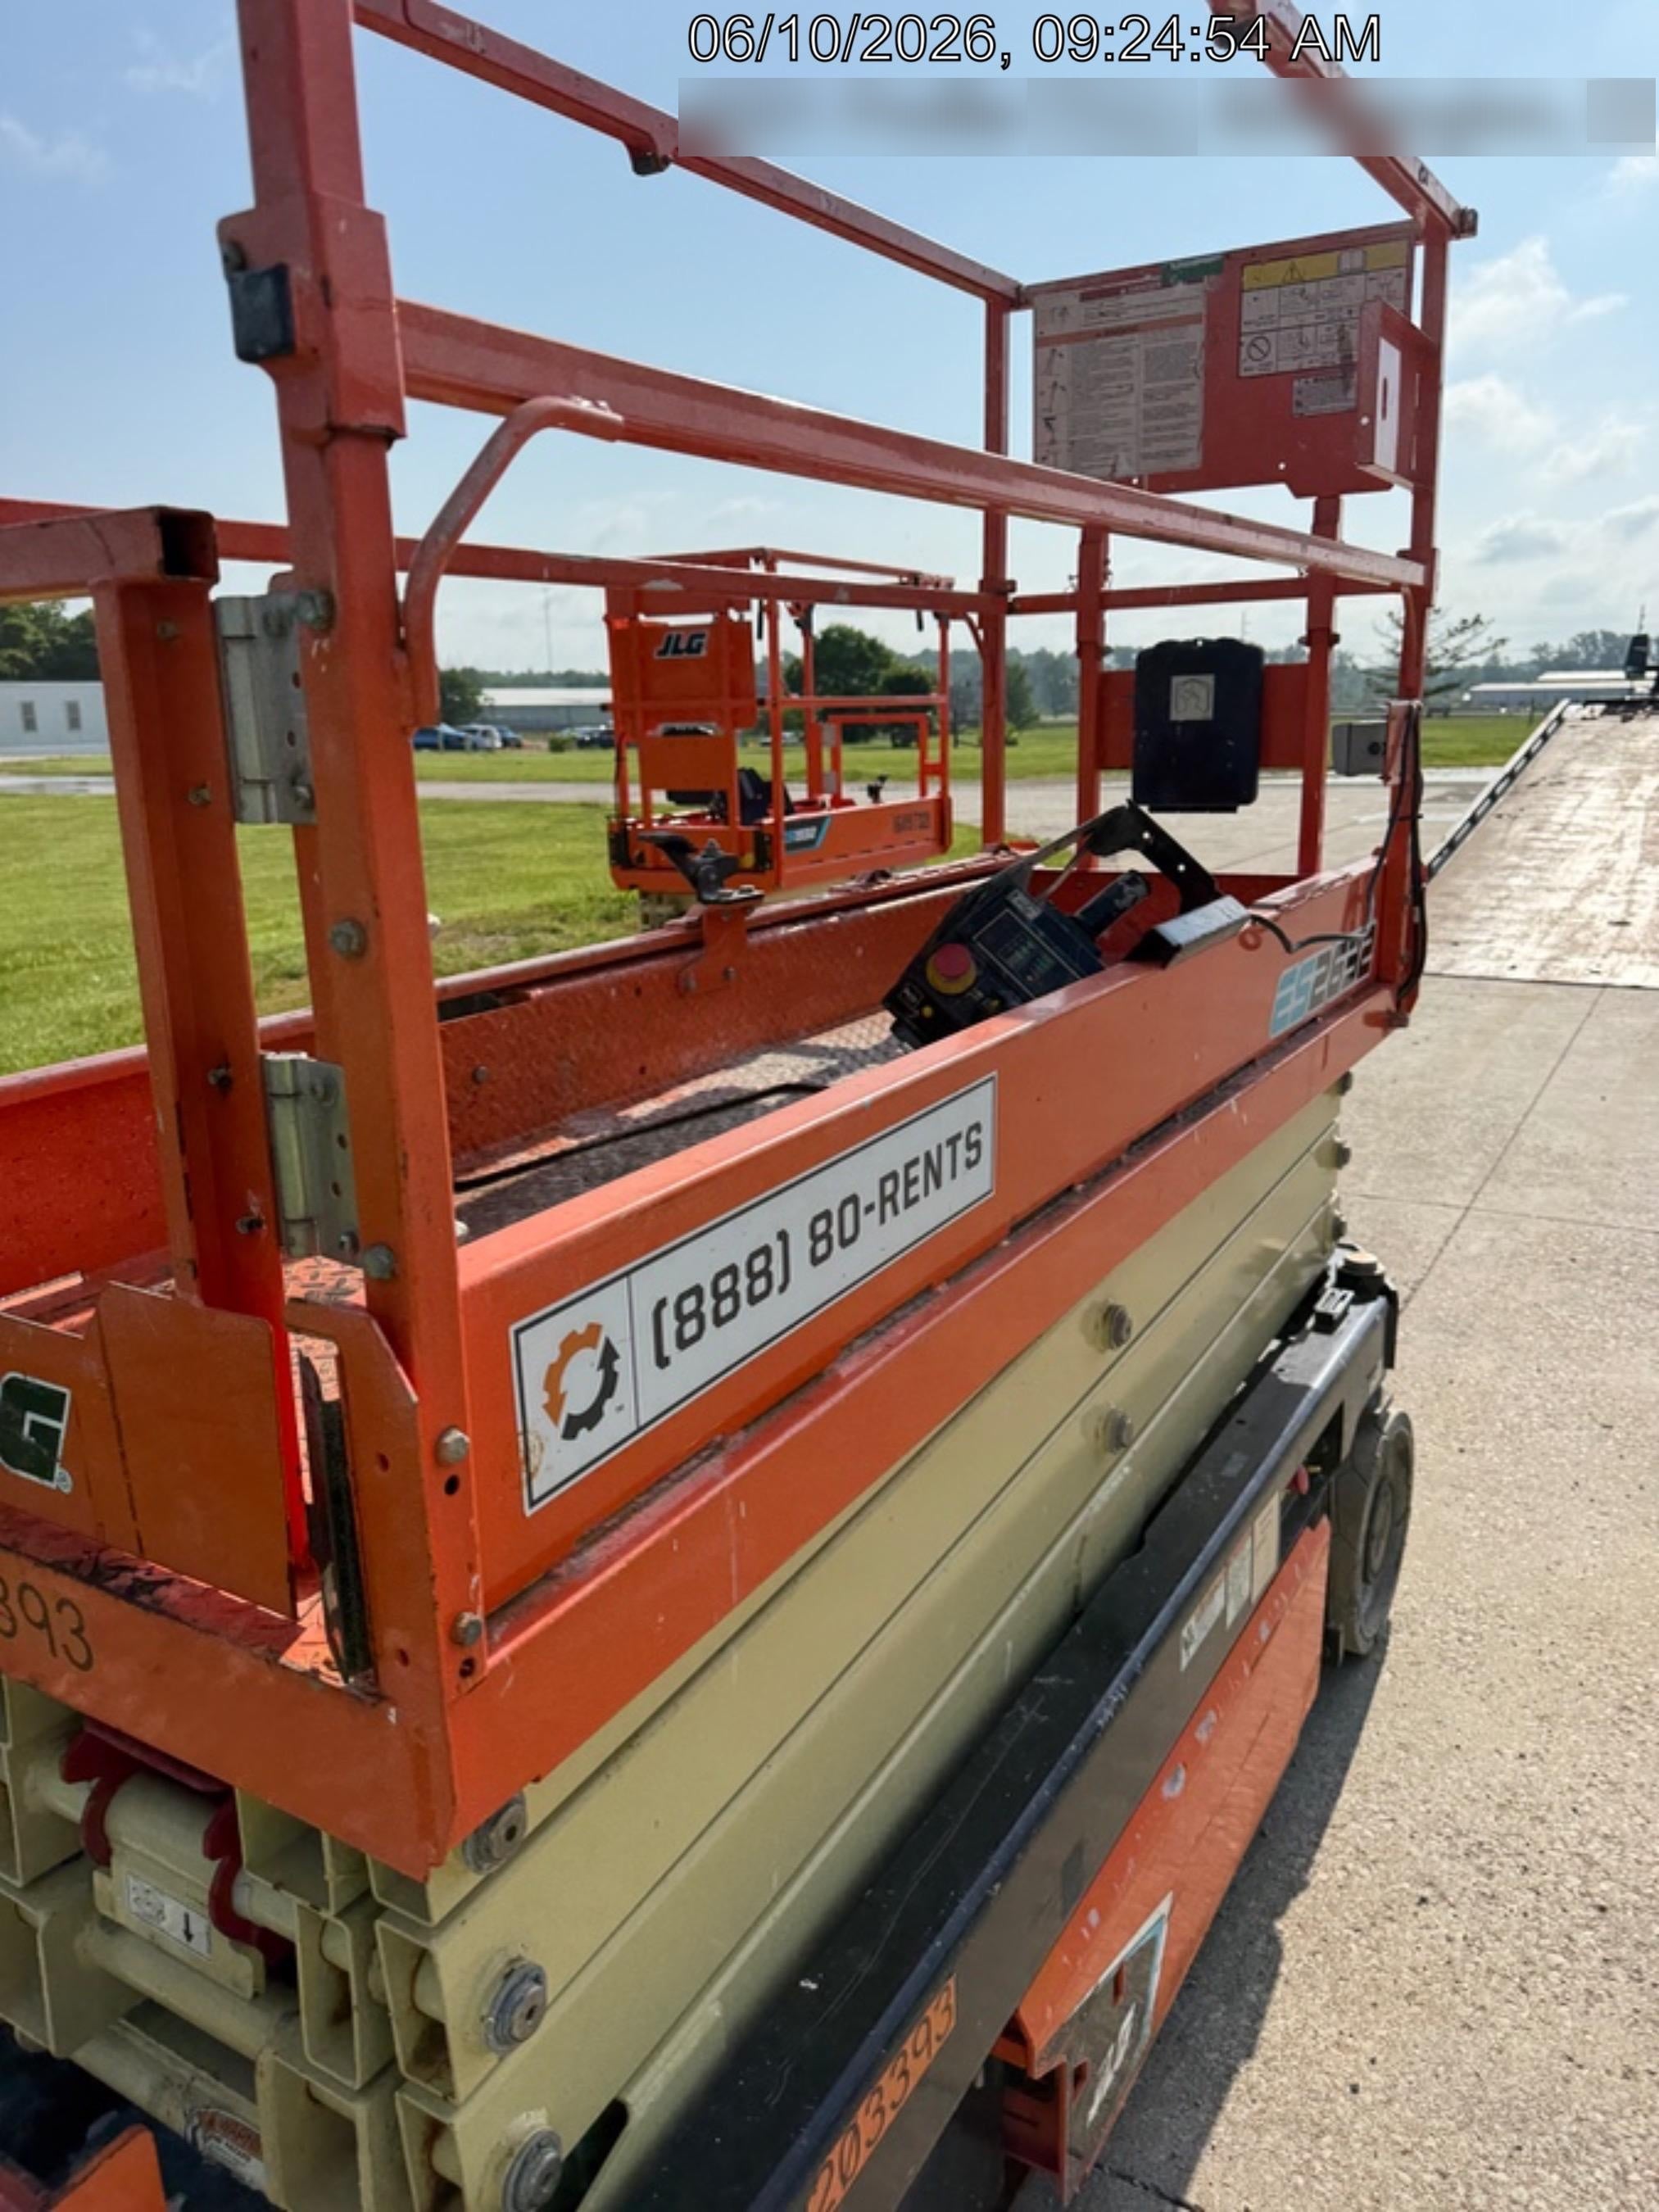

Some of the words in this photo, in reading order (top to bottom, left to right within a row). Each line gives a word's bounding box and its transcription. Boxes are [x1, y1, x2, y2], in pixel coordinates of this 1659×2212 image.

[655, 631, 709, 659] JLG
[650, 1229, 791, 1370] (888)
[807, 1121, 983, 1267] 80-RENTS
[814, 1984, 953, 2212] 203393
